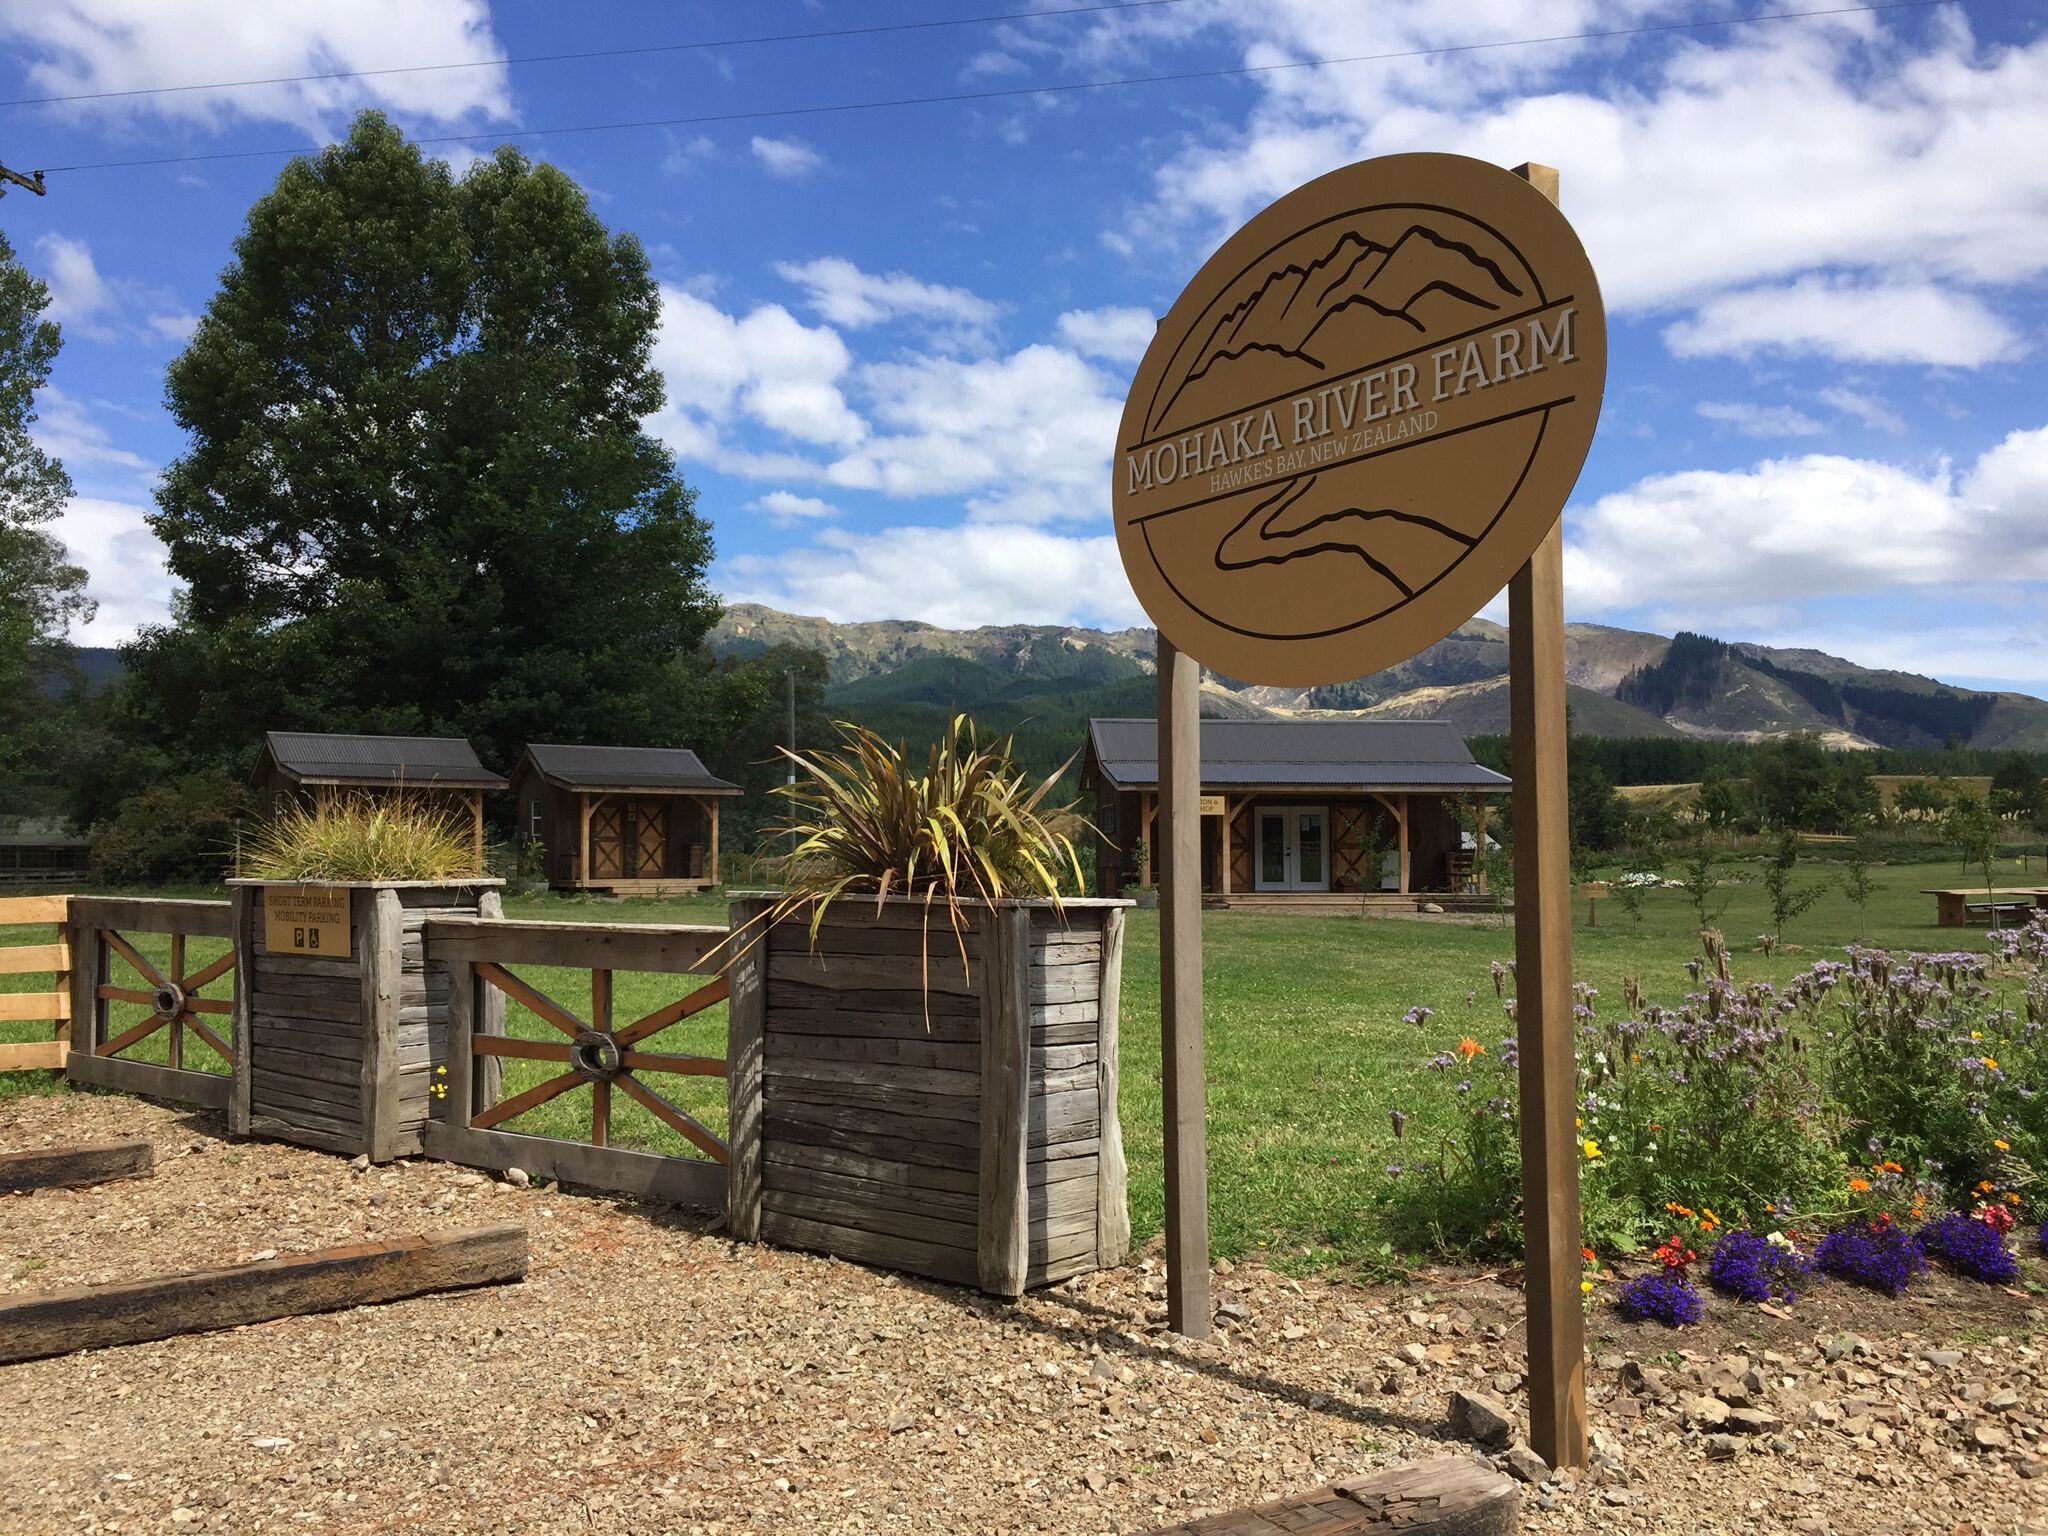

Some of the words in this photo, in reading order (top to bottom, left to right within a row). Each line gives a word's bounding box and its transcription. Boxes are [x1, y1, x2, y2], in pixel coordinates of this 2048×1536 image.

[1127, 409, 1283, 495] MOHAKA
[1292, 363, 1420, 444] RIVER
[1431, 307, 1576, 401] FARM
[1210, 459, 1273, 493] HAWKE'S
[1276, 449, 1306, 474] BAY,
[1310, 436, 1349, 465] NEW
[1352, 410, 1438, 452] ZEALAND
[269, 895, 291, 907] SHORT
[292, 896, 312, 908] TERM
[313, 896, 345, 909] PARKING
[274, 910, 308, 923] MOBILITY
[308, 912, 340, 924] PARKING
